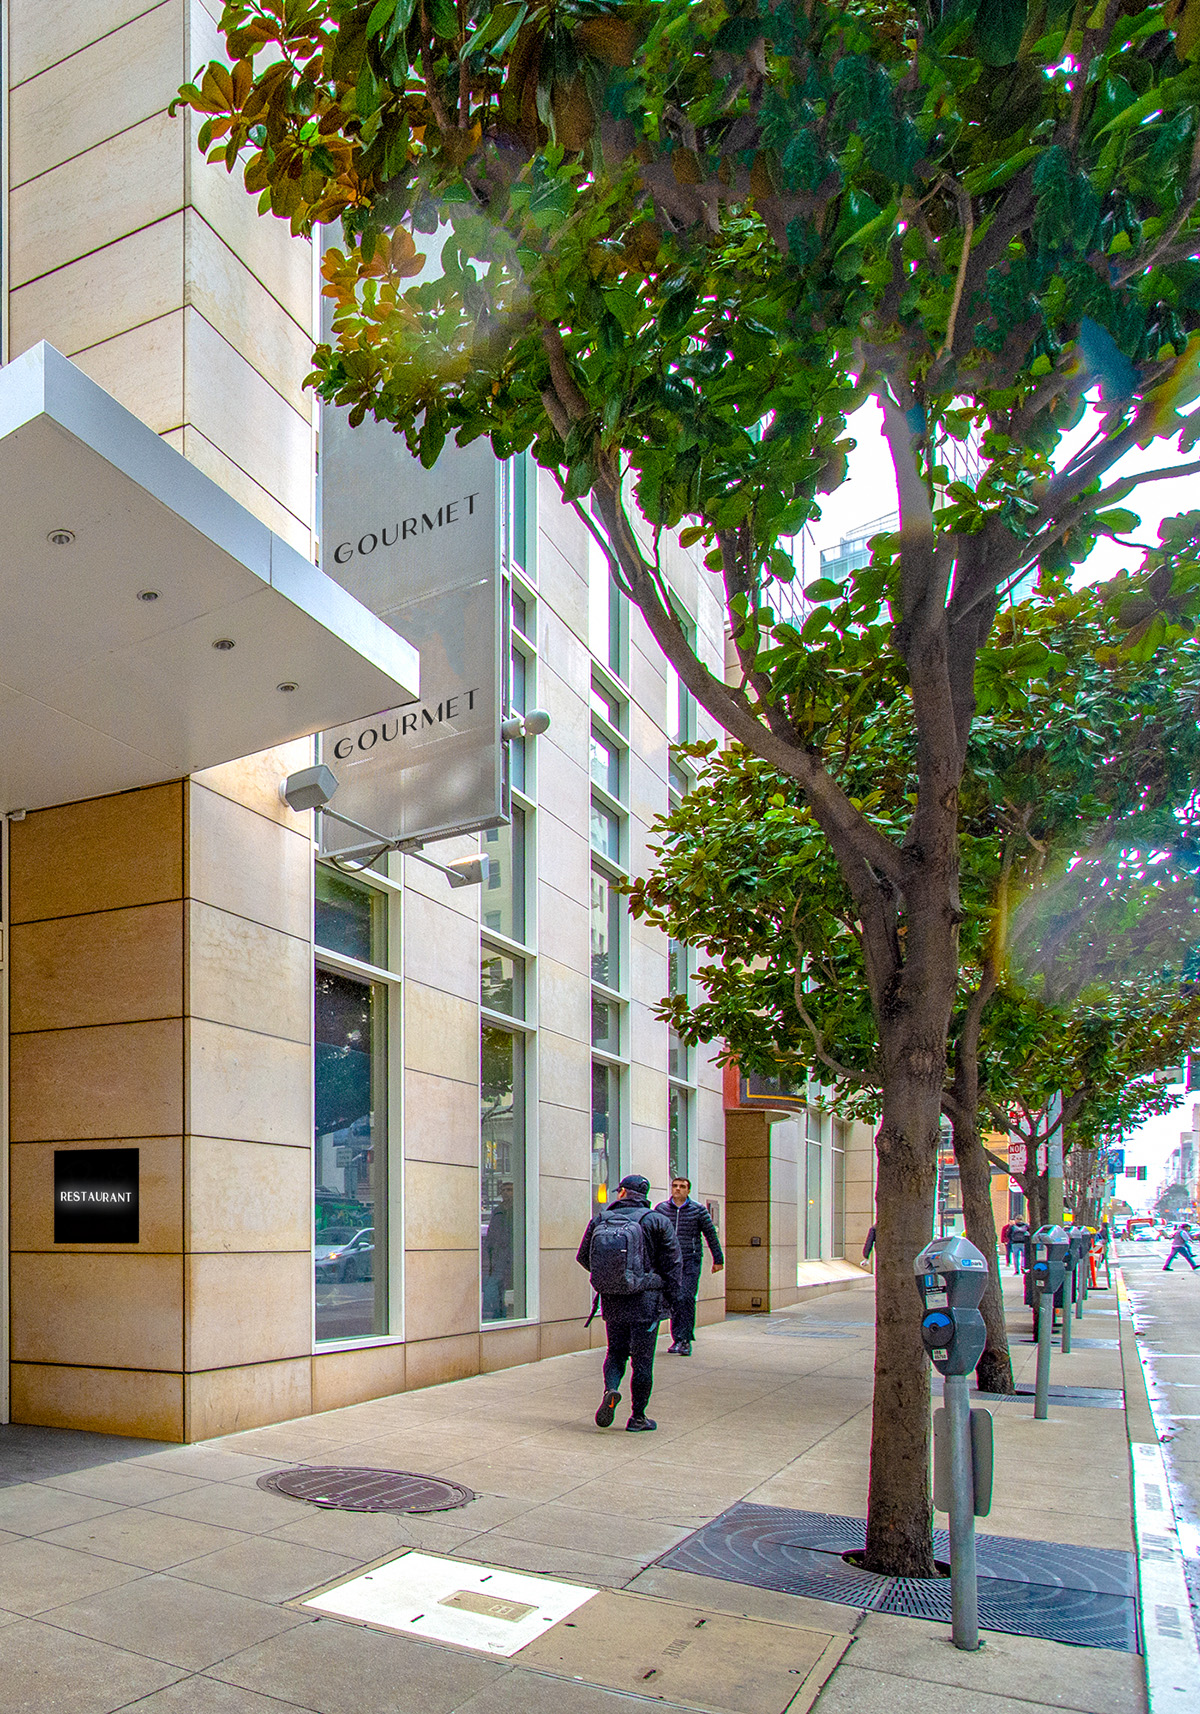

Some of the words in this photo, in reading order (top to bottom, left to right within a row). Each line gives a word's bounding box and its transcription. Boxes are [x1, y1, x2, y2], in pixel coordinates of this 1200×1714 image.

[333, 493, 480, 564] GOURMET
[333, 688, 480, 759] GOURMET
[60, 1191, 132, 1203] RESTAURANT
